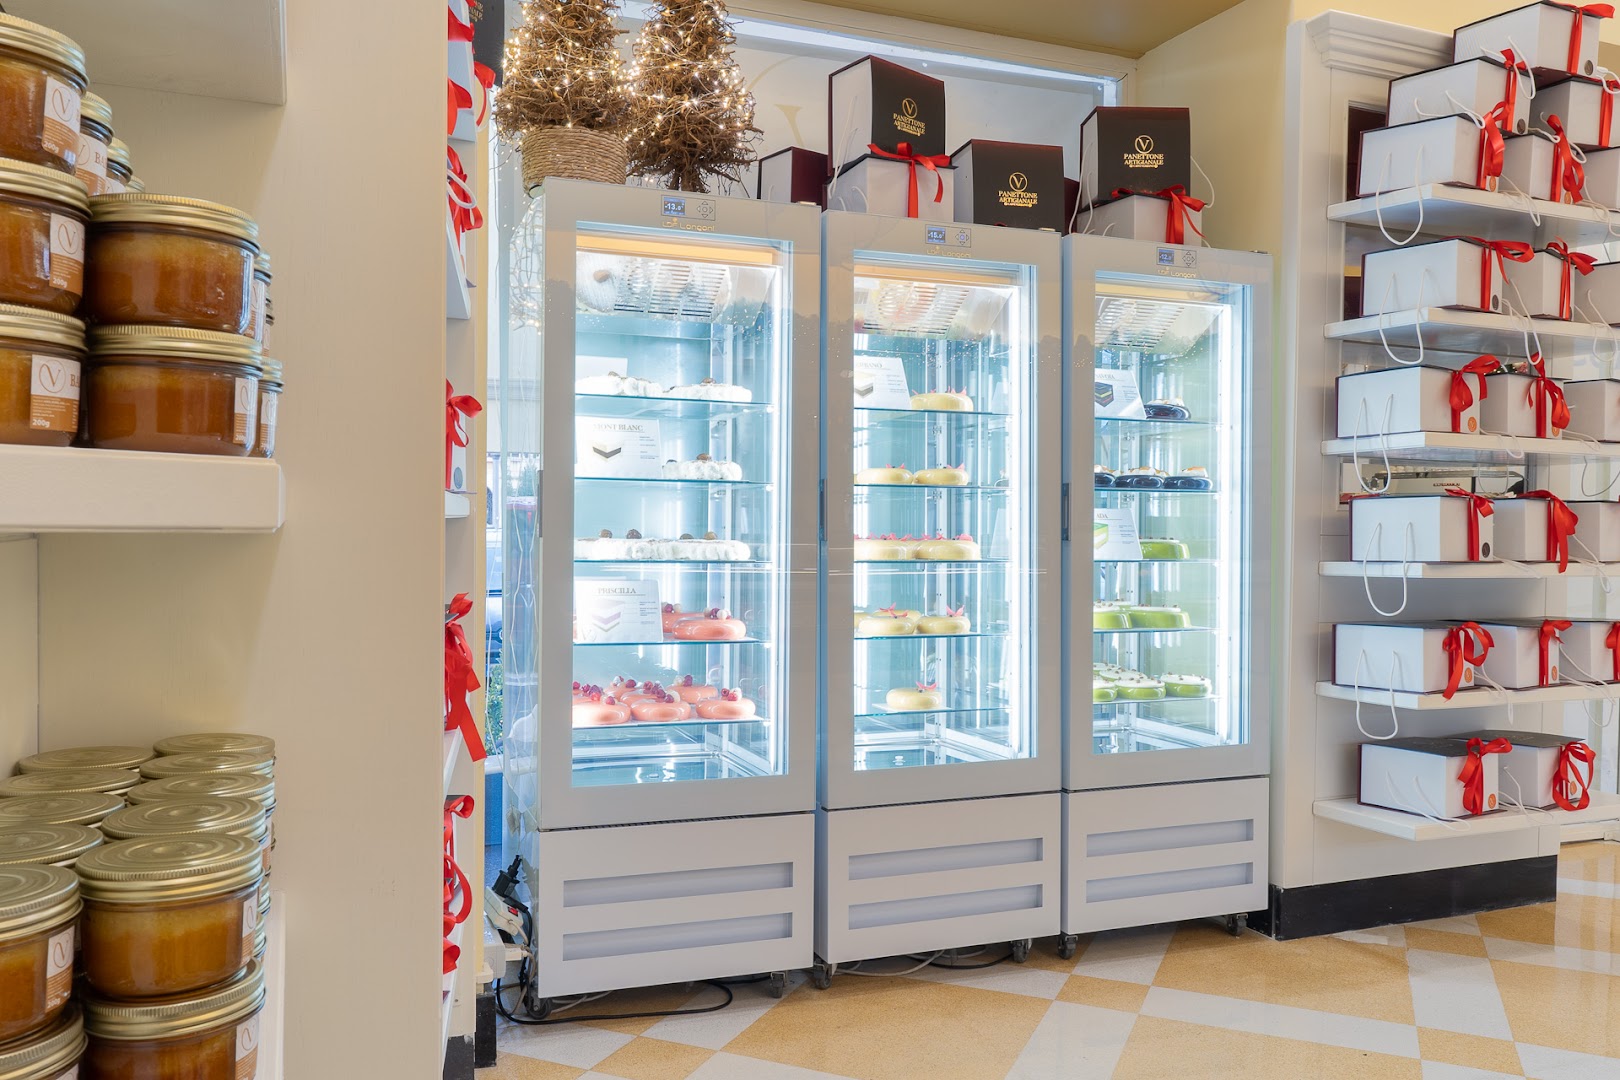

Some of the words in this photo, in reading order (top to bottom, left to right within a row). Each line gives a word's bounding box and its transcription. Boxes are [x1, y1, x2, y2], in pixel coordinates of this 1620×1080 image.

[893, 113, 925, 128] PANETTONE
[894, 120, 925, 134] ARTIGIANALE
[43, 141, 59, 153] 200g
[998, 190, 1038, 199] PANETTONE
[53, 277, 68, 288] 200g
[32, 418, 50, 428] 200g
